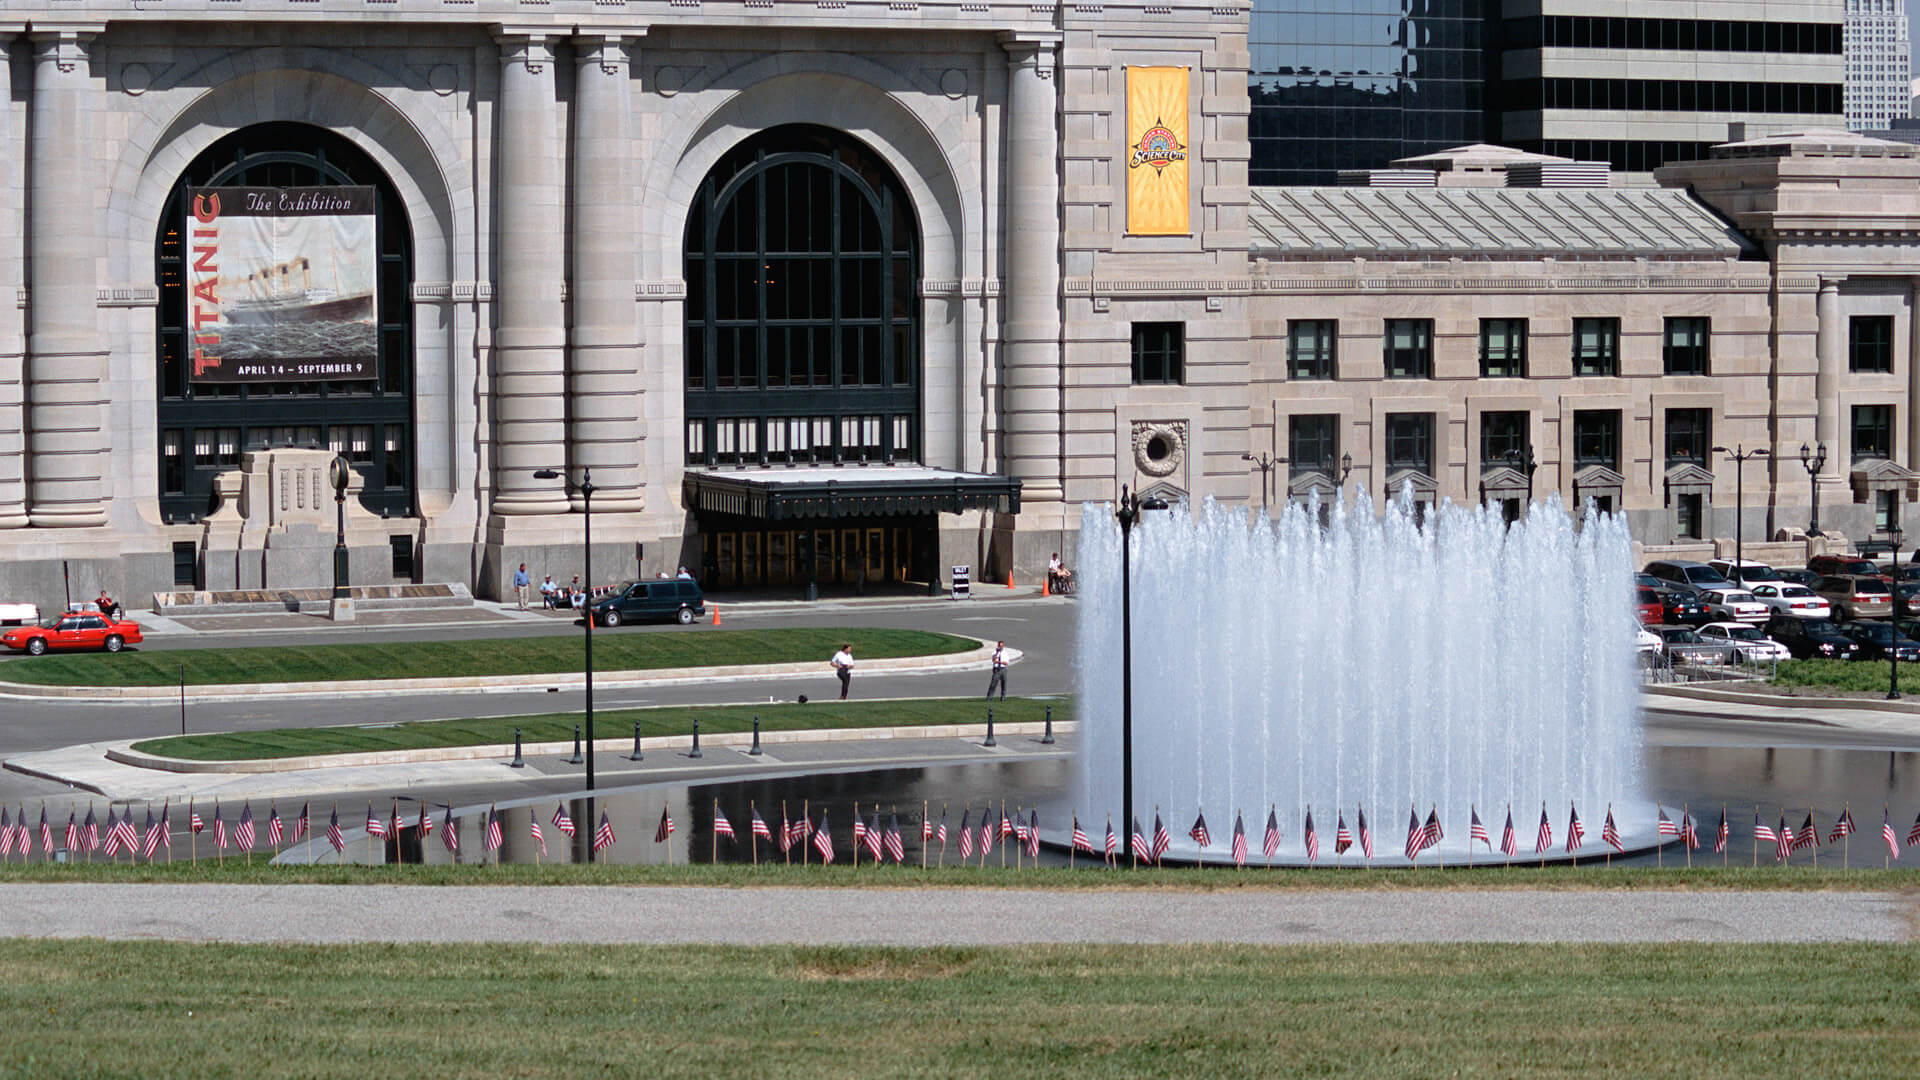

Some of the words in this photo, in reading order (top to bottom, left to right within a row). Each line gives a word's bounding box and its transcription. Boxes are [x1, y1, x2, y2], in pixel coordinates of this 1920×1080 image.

[247, 192, 272, 211] The
[279, 192, 351, 211] Exhibition
[193, 192, 222, 376] TITANIC
[238, 365, 267, 376] APRIL
[271, 365, 284, 375] 14
[298, 363, 353, 375] SEPTEMBER
[356, 362, 363, 373] 9
